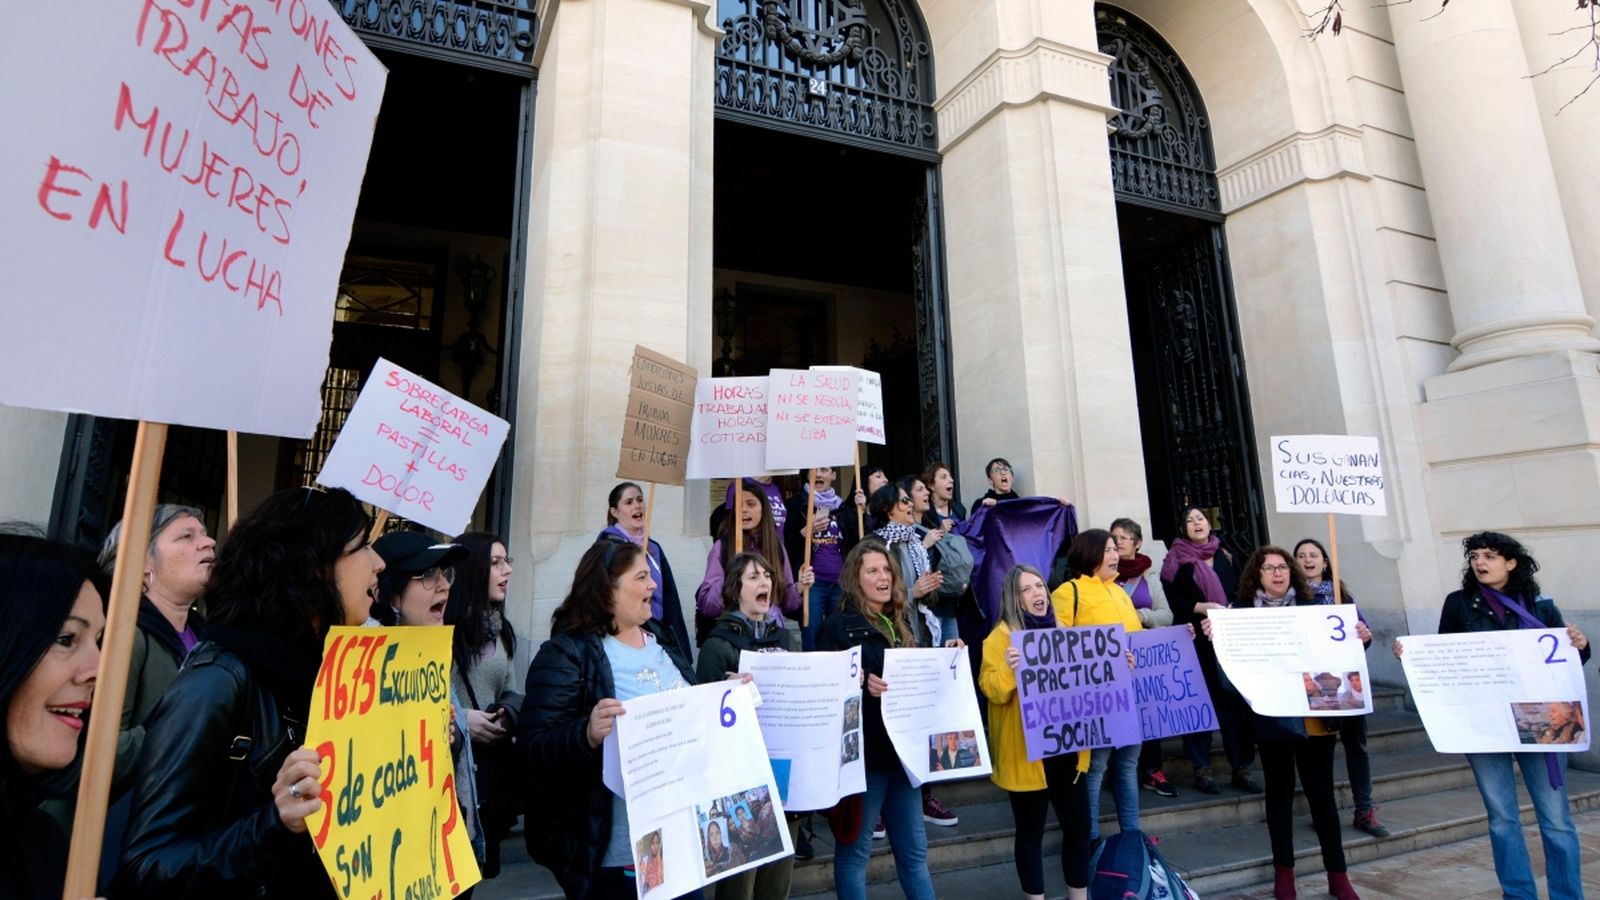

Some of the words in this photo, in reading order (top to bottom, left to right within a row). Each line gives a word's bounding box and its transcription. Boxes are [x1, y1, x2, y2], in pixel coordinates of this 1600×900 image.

[288, 63, 333, 129] DE
[809, 78, 826, 95] 24
[114, 82, 291, 245] MUJERES
[38, 155, 128, 234] EN
[164, 209, 283, 316] LUCHA
[714, 384, 763, 401] HORAS
[778, 393, 792, 404] NI
[797, 394, 809, 405] SE
[791, 374, 806, 388] LA
[814, 374, 850, 390] SALUD
[385, 371, 490, 437] SOBRECARGA
[399, 399, 472, 446] LABORAL
[718, 416, 764, 428] HORAS
[776, 411, 789, 421] NI
[794, 413, 811, 423] SE
[376, 423, 468, 482] PASTILLAS
[1278, 440, 1328, 464] SUS
[361, 463, 435, 512] DOLOR
[1326, 614, 1346, 641] 3
[850, 651, 858, 678] 5
[949, 649, 959, 680] 4
[1022, 627, 1121, 666] CORREOS
[1537, 633, 1567, 664] 2
[316, 635, 388, 721] 1675
[1021, 660, 1116, 697] PRACTICA
[1132, 674, 1172, 705] AMOS,
[1171, 665, 1198, 702] SE
[720, 689, 737, 728] 6
[1140, 707, 1157, 739] EL
[1157, 702, 1212, 736] MUNDO
[1043, 717, 1112, 755] SOCIAL
[336, 737, 365, 827] de
[371, 729, 419, 809] cada
[419, 719, 434, 790] 4
